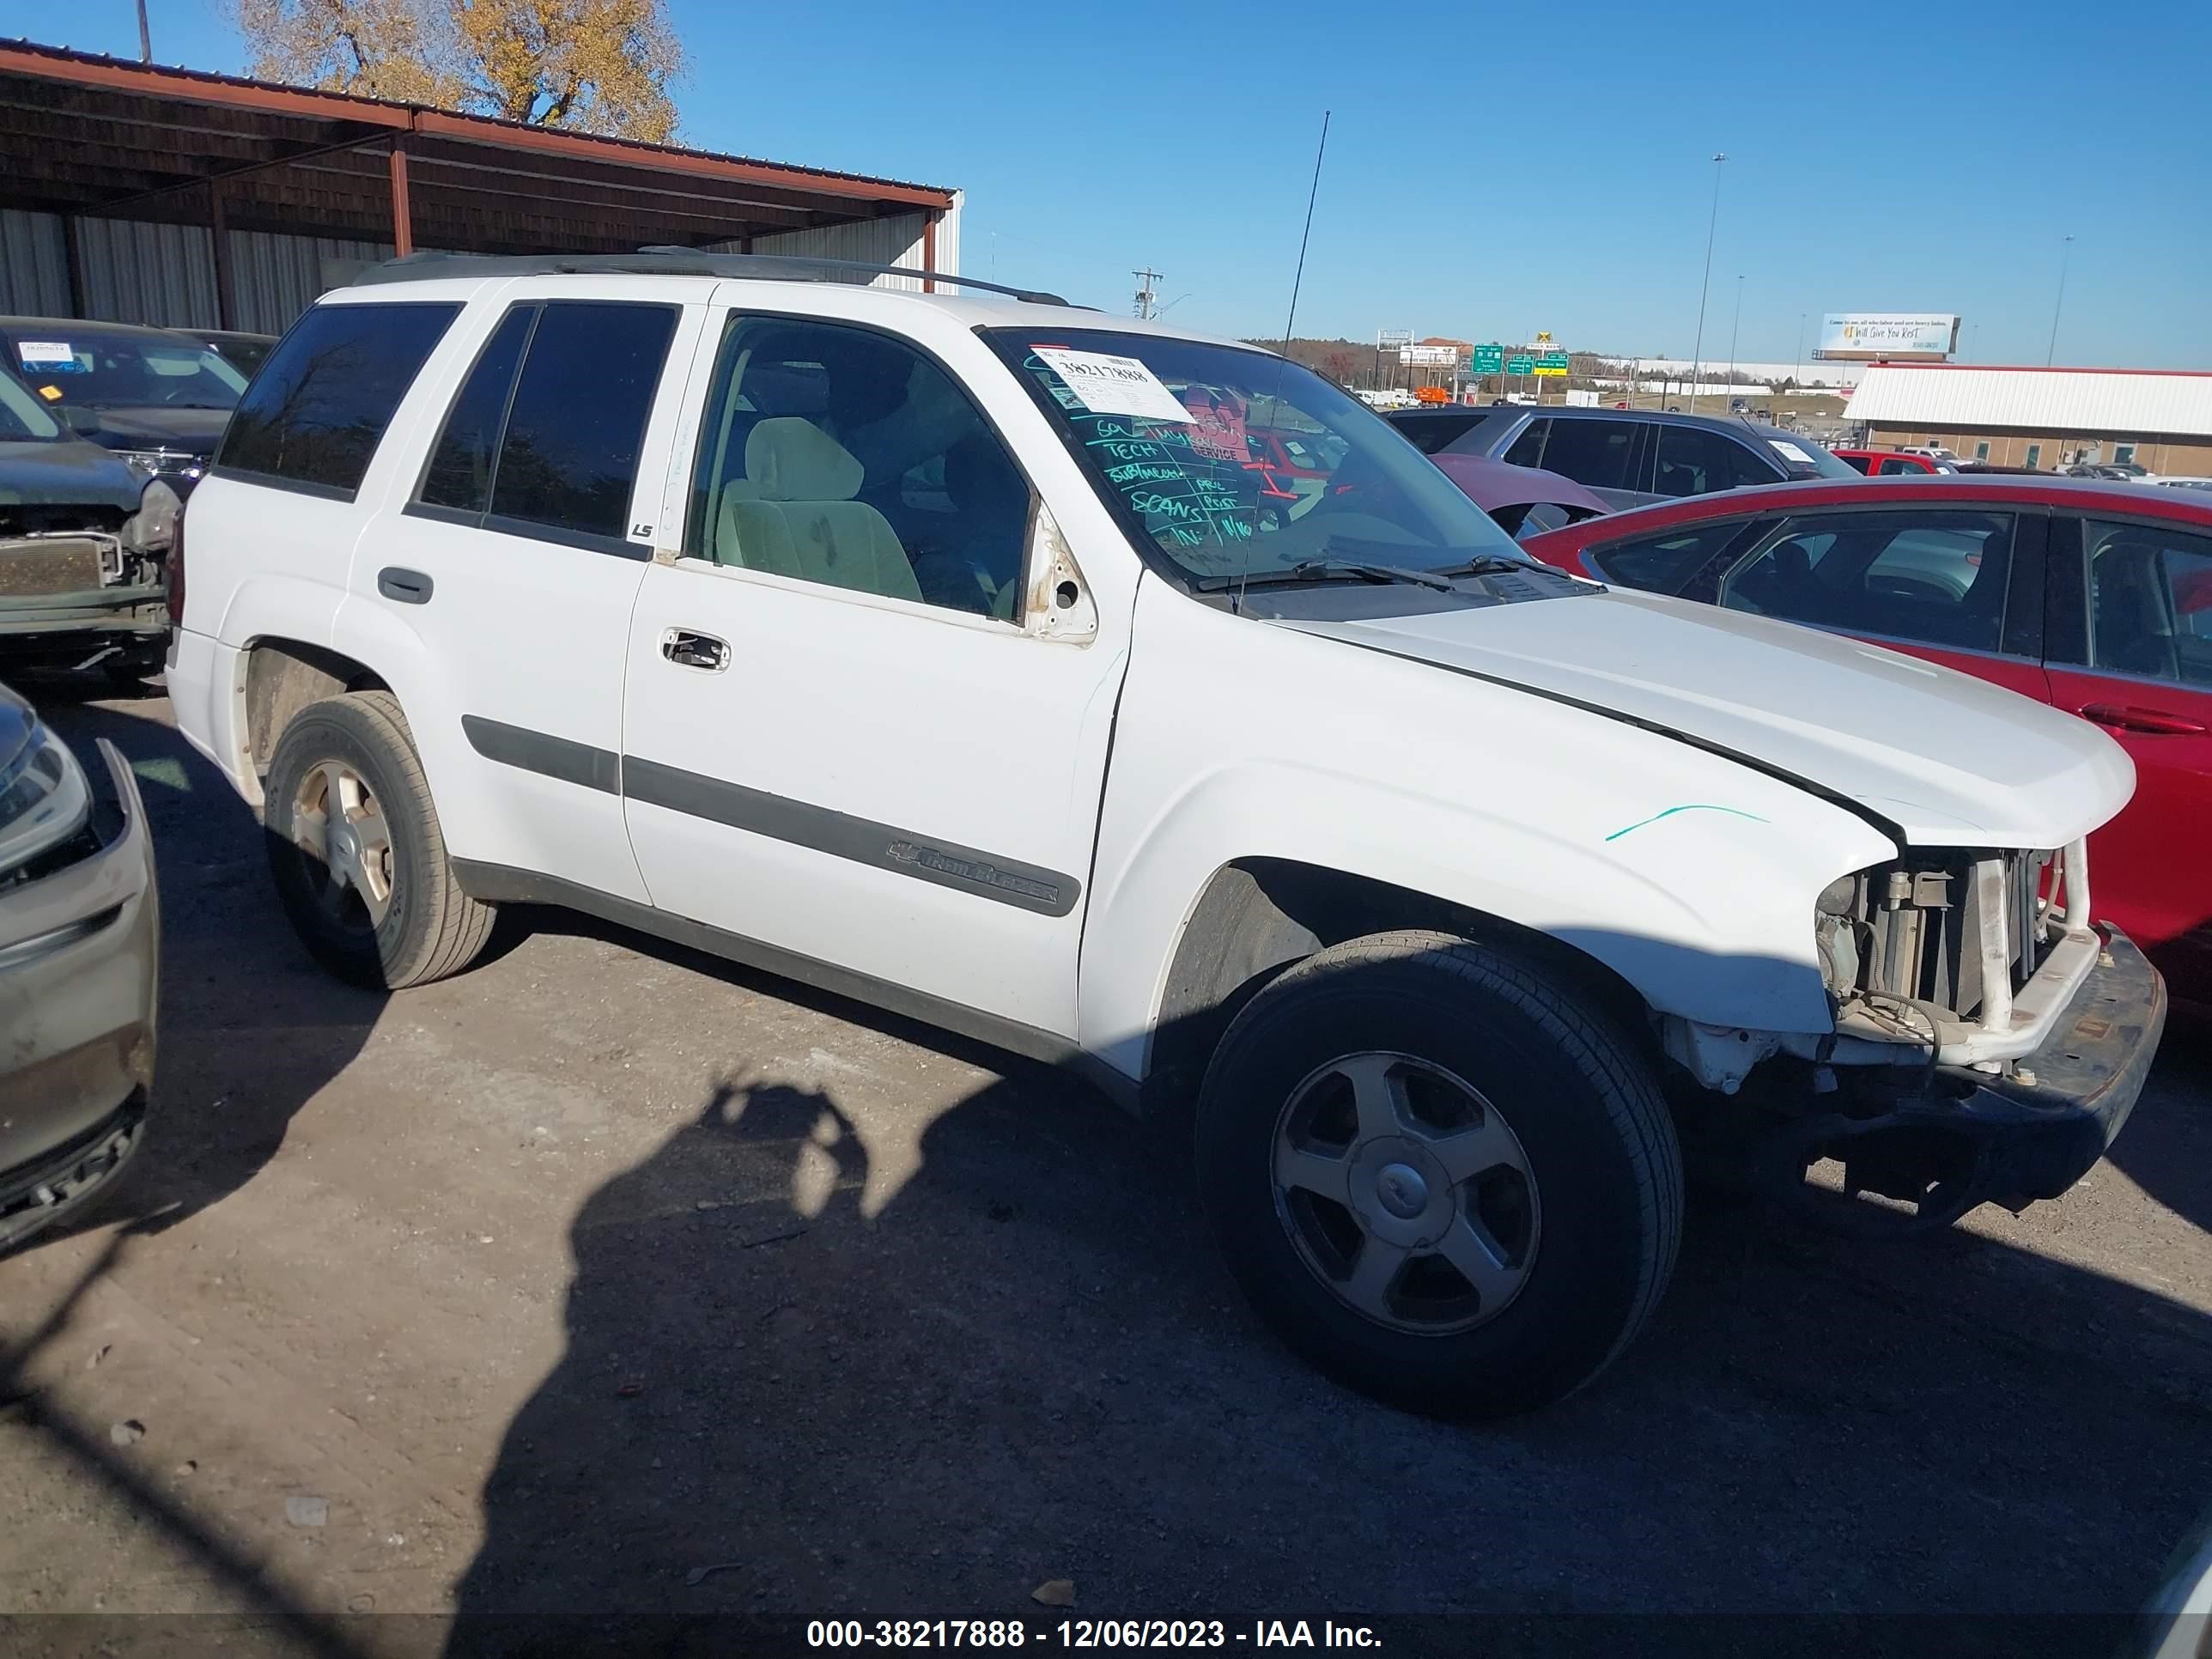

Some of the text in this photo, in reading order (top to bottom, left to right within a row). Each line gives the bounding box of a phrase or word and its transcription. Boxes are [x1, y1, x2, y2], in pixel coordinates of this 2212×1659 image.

[1869, 326, 1885, 338] Give
[1887, 327, 1899, 339] You
[1059, 362, 1148, 383] 38217888
[1103, 442, 1159, 459] TECH
[1193, 445, 1237, 460] SERVICE
[1131, 491, 1203, 522] SCANS
[632, 524, 653, 538] LS
